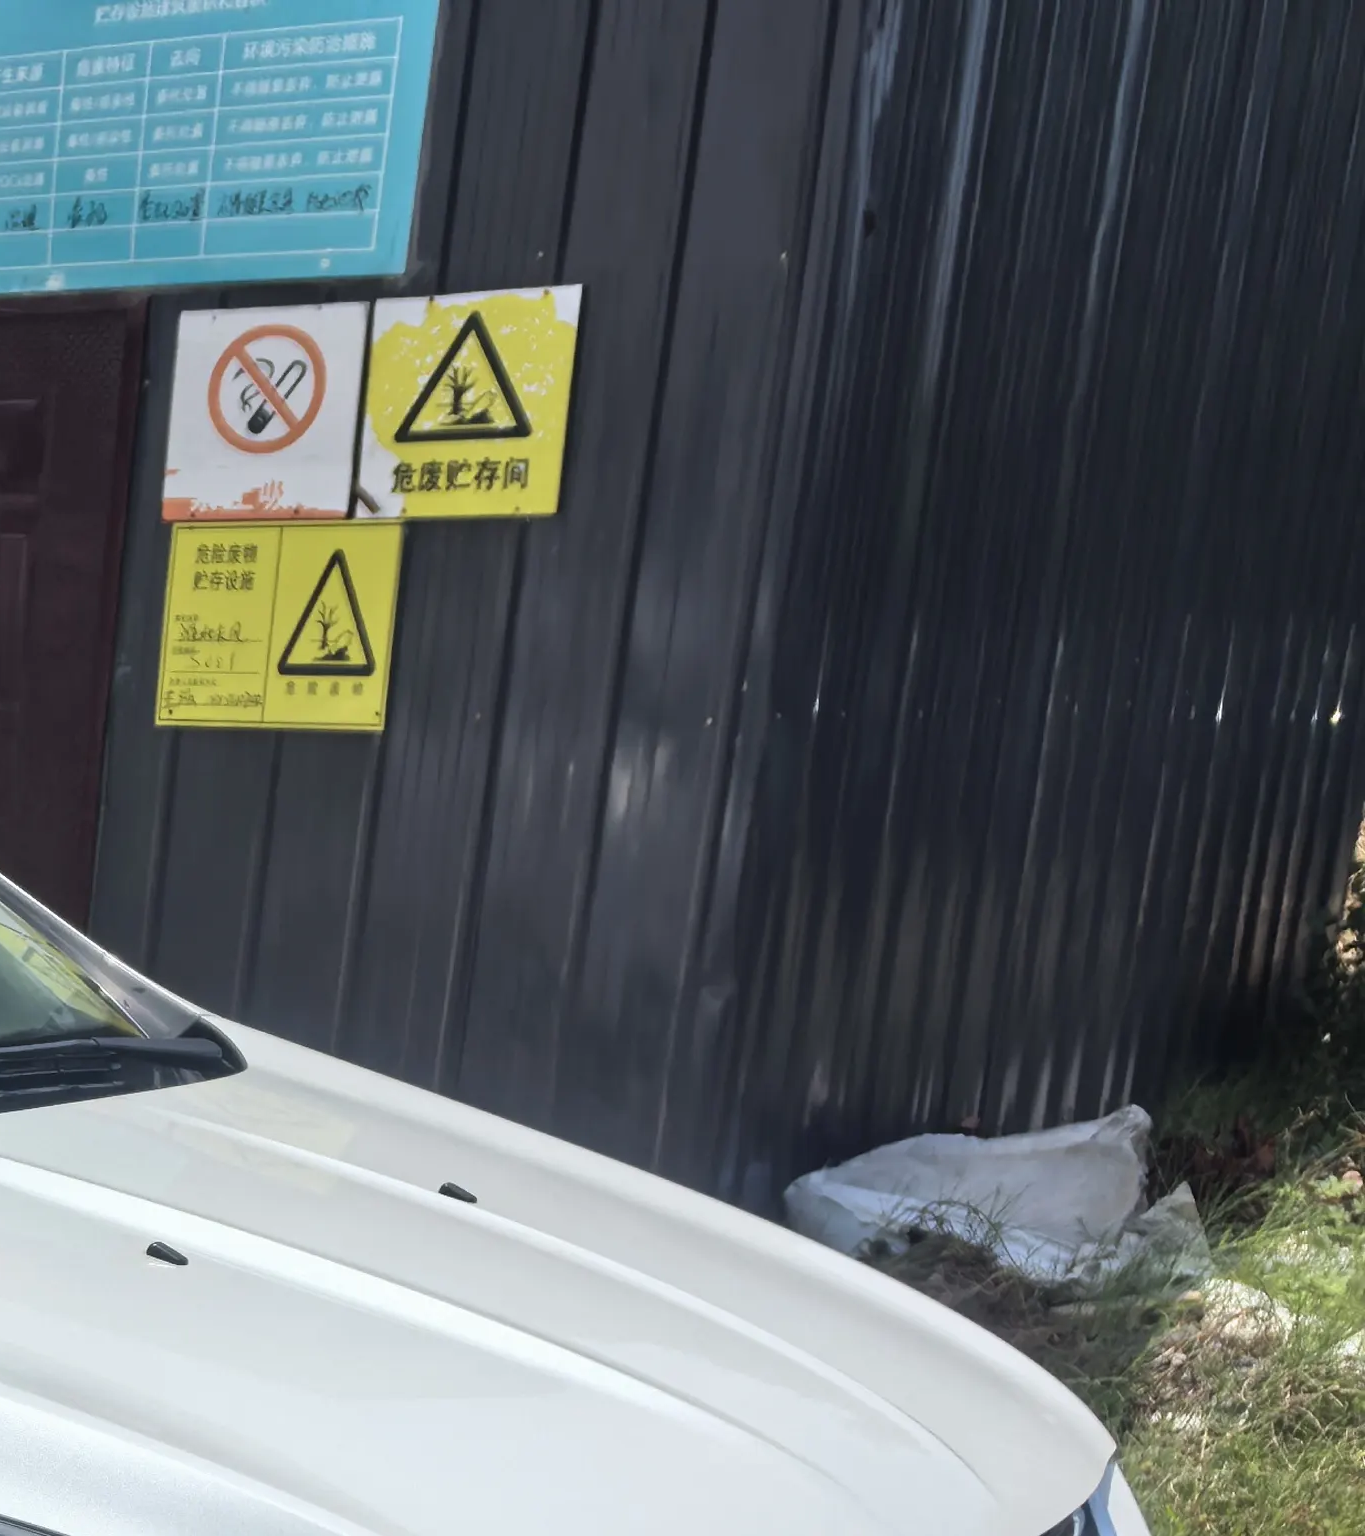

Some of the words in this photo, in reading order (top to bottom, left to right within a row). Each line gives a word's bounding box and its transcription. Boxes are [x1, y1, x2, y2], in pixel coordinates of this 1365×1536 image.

[391, 456, 530, 493] 危废贮存间
[194, 542, 258, 564] 危险废物
[193, 570, 256, 591] 贮存设施
